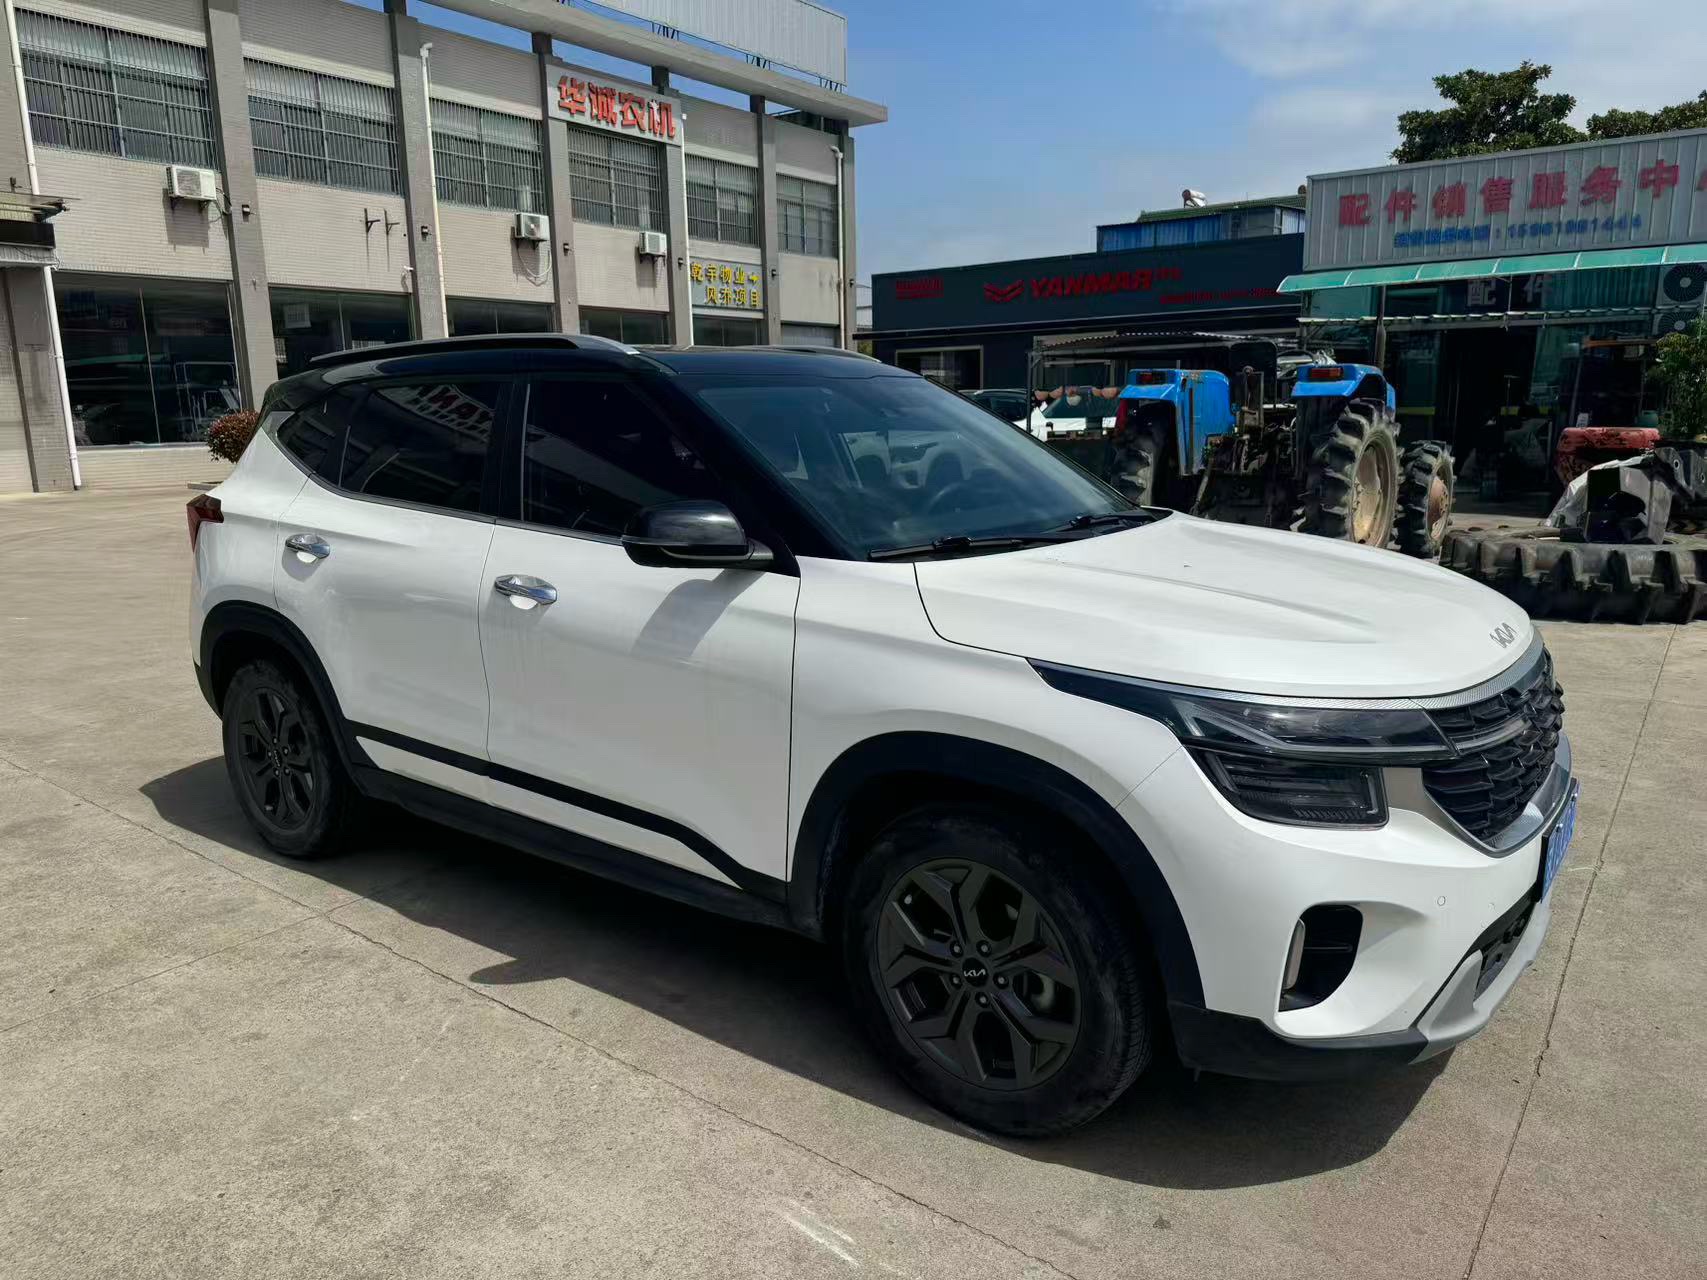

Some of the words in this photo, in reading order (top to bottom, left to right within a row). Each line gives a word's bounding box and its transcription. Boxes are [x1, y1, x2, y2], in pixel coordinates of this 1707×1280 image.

[558, 75, 676, 139] 华诚农机
[1339, 158, 1707, 226] 配件销售服务中
[1031, 269, 1153, 298] YANMAR
[1489, 622, 1518, 648] KIA
[963, 968, 987, 977] KIA
